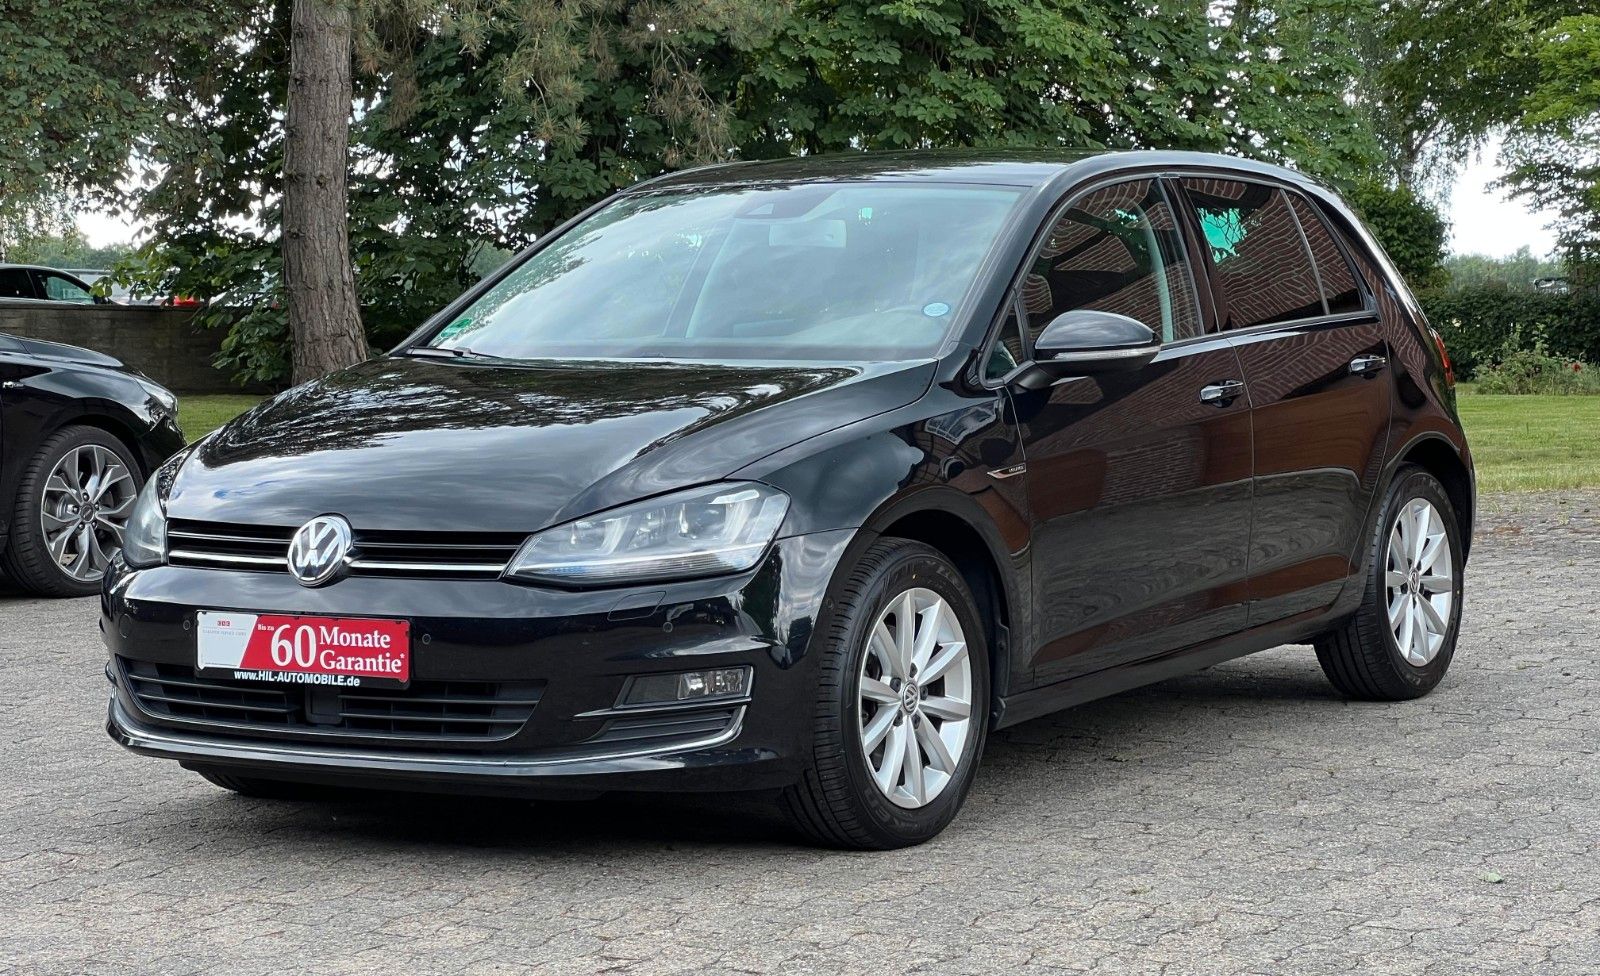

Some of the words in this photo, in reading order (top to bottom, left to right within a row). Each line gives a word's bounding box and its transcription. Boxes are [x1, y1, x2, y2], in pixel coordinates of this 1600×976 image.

[270, 624, 317, 667] 60
[319, 625, 391, 648] Monate
[233, 670, 361, 687] www.HIL-AUTOMOBILE.de
